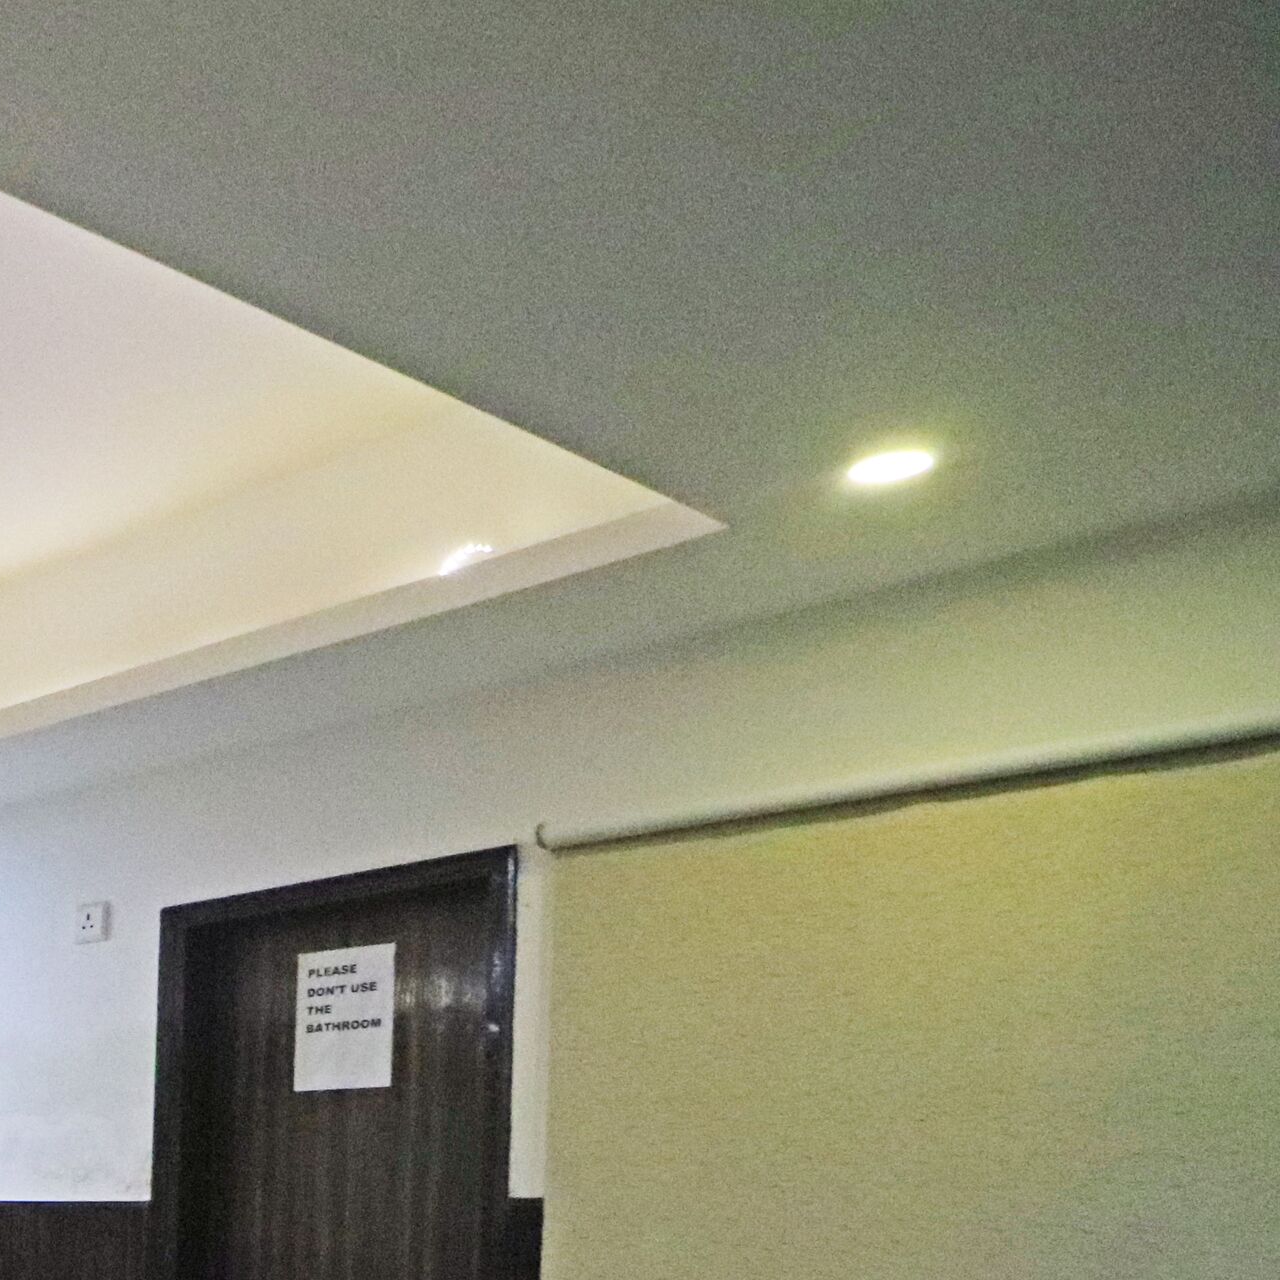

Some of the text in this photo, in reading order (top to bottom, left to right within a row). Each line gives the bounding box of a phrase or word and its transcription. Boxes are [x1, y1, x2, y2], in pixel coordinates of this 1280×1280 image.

[307, 963, 358, 979] PLEASE
[307, 981, 378, 998] DON'T USE
[306, 1004, 332, 1016] THE
[305, 1018, 382, 1034] BATHROOM
